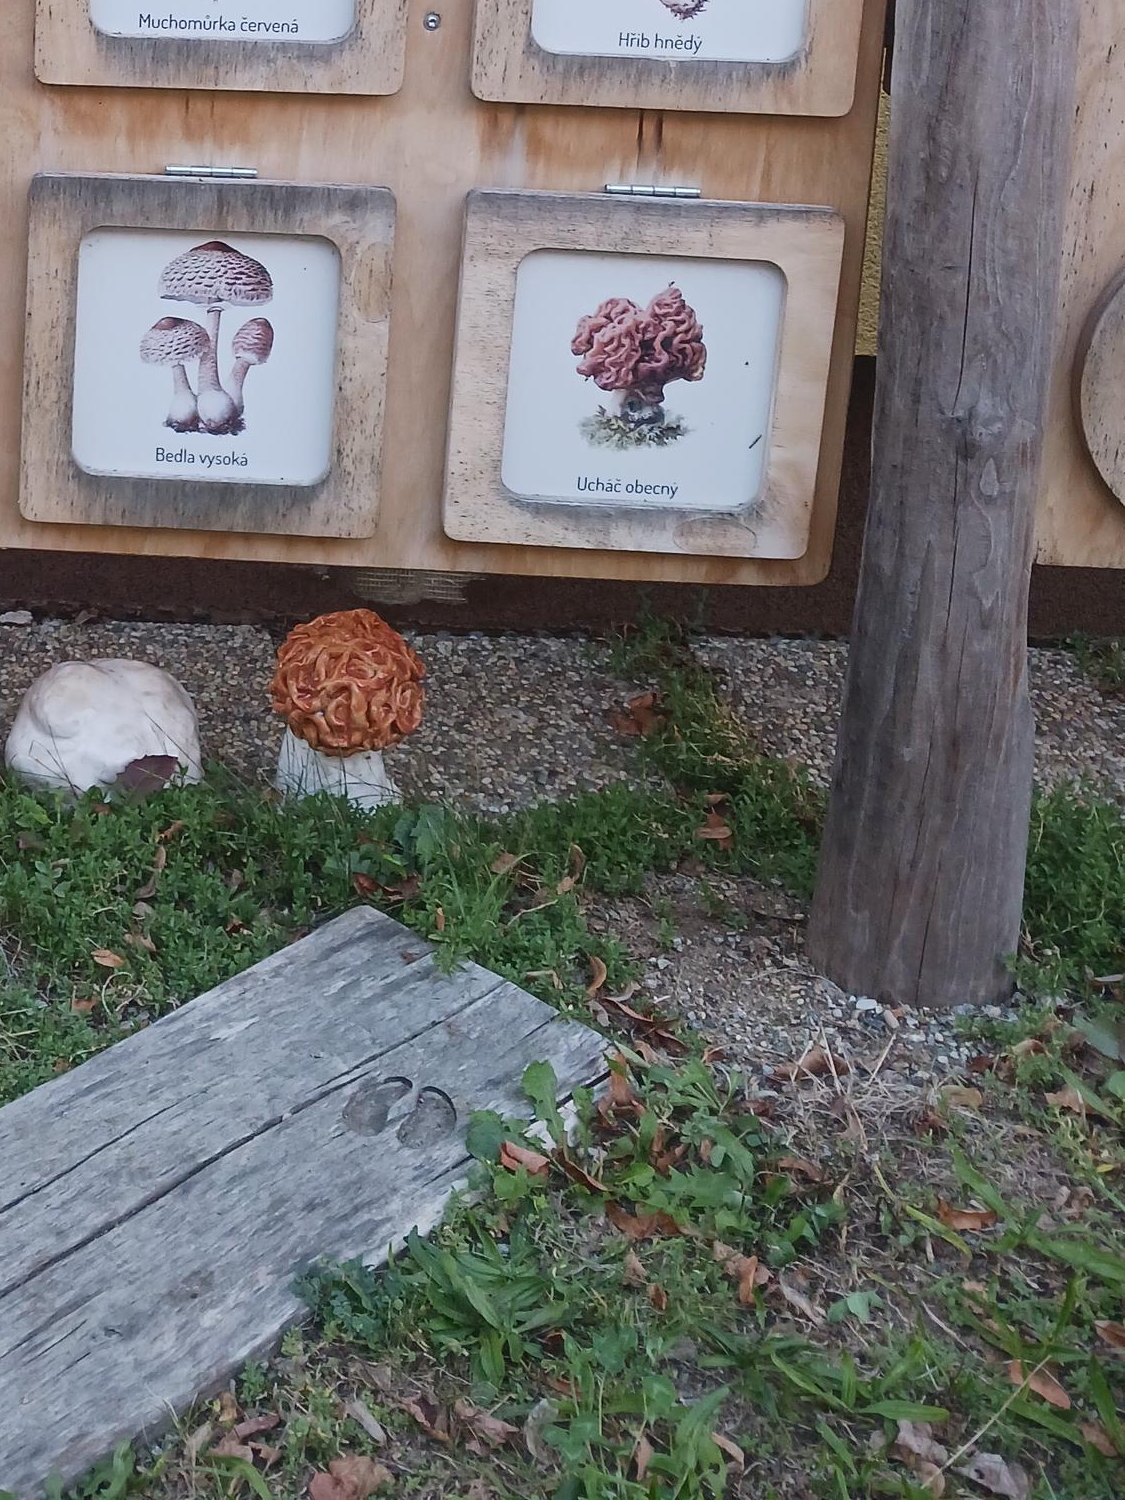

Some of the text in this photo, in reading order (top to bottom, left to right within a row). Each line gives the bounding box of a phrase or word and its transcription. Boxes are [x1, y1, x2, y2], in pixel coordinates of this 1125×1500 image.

[138, 13, 299, 34] Muchomůrka červená
[618, 31, 703, 55] Hřib hnědý
[155, 446, 249, 469] Bedla vysoká
[577, 476, 679, 500] Ucháč obecný
